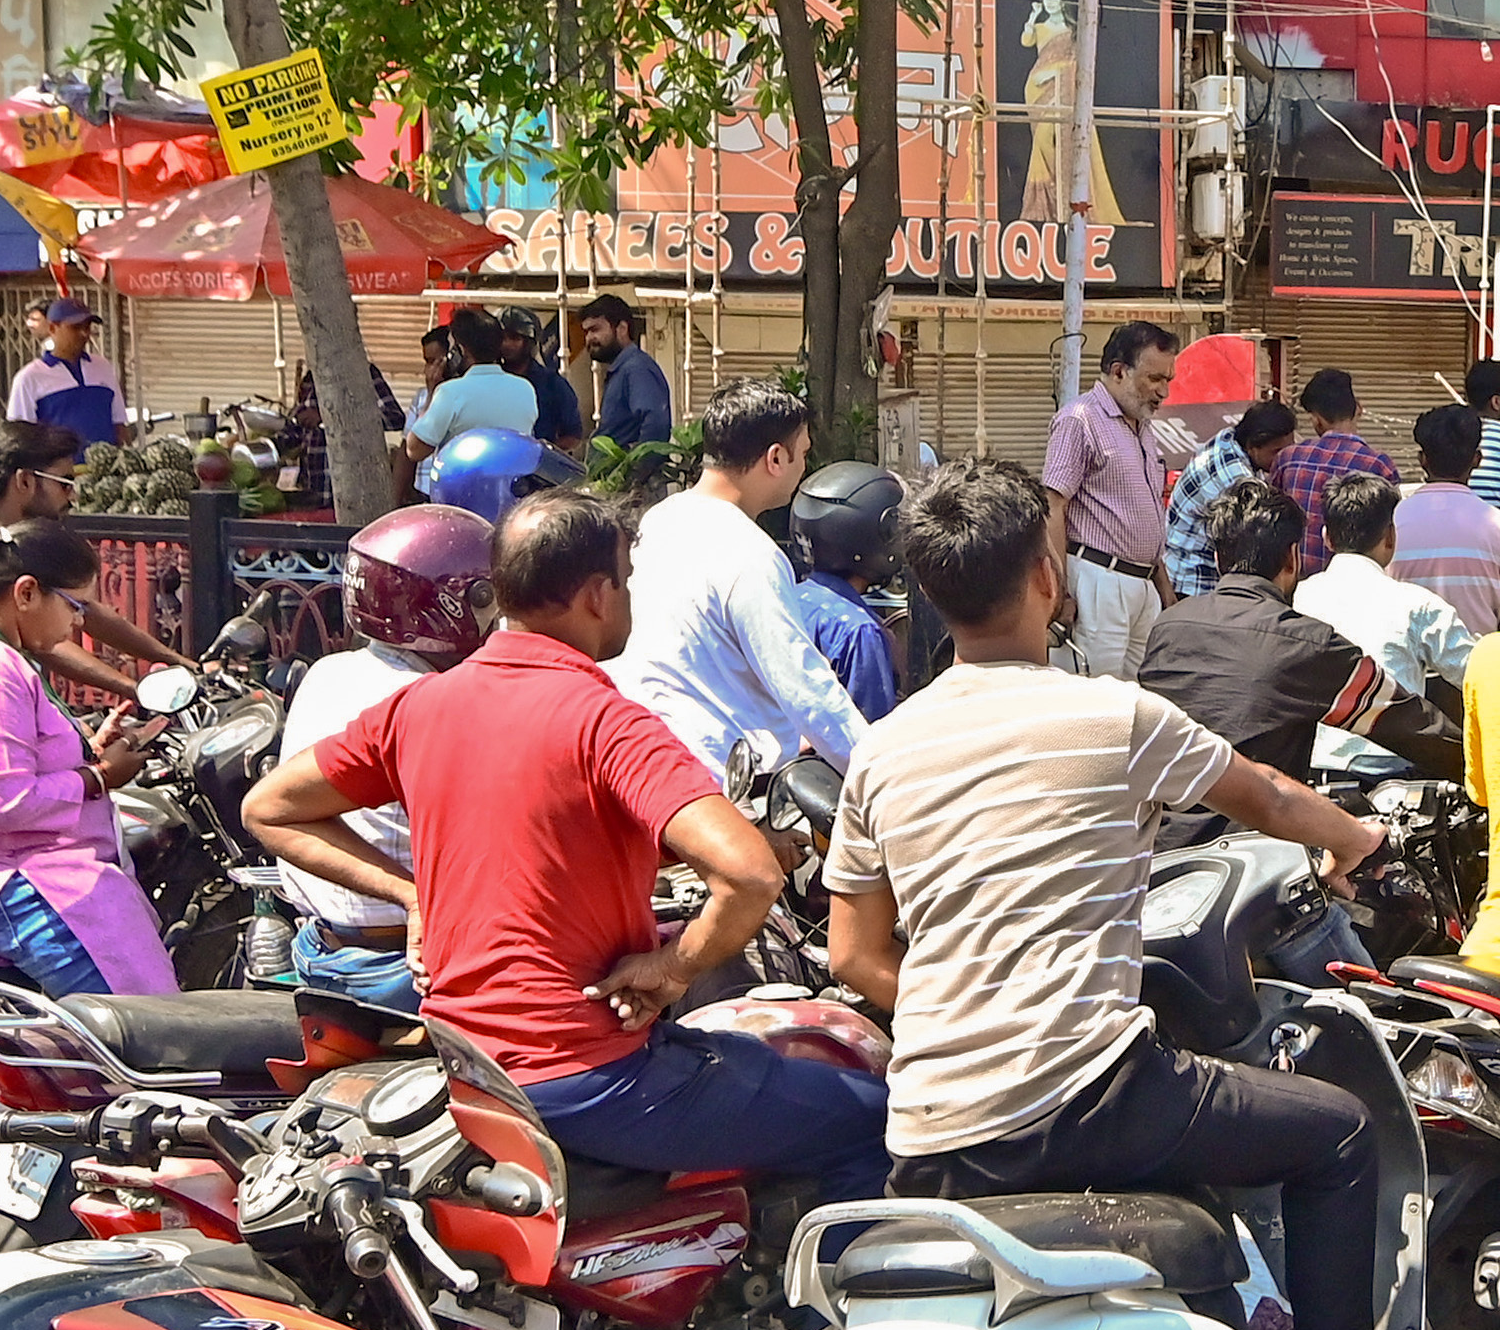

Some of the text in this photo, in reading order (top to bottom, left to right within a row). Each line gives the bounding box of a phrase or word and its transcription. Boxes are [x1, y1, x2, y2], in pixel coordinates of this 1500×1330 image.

[219, 60, 319, 106] NO PARKING
[261, 94, 322, 121] TUITIONS
[239, 120, 315, 152] Nursery to
[485, 209, 804, 274] SAREES &
[128, 270, 244, 292] ACCESSORIES
